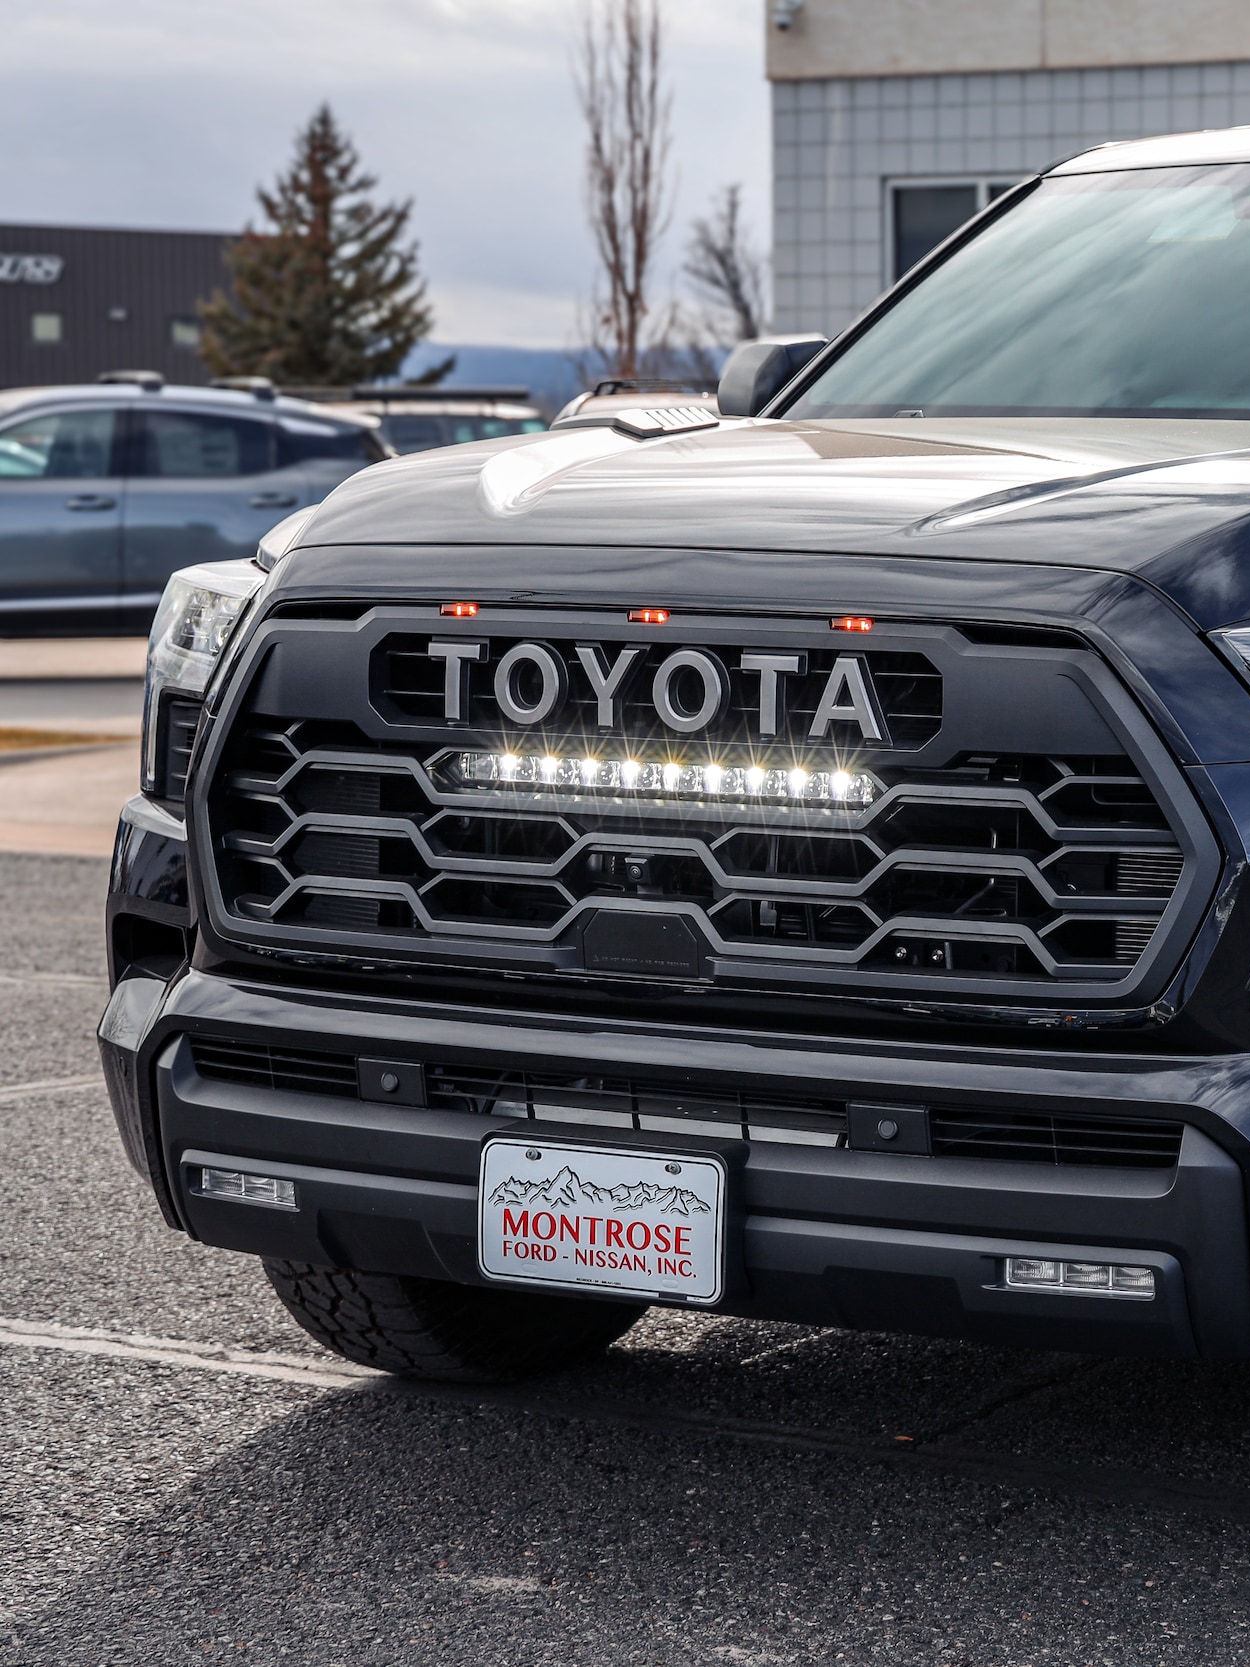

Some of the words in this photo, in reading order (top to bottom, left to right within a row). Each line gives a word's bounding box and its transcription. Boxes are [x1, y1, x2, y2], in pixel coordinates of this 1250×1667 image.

[428, 639, 888, 744] TOYOTA
[503, 1208, 692, 1256] MONTROSE
[503, 1240, 557, 1262] FORD
[574, 1249, 652, 1276] NISSAN,
[657, 1257, 697, 1278] INC.
